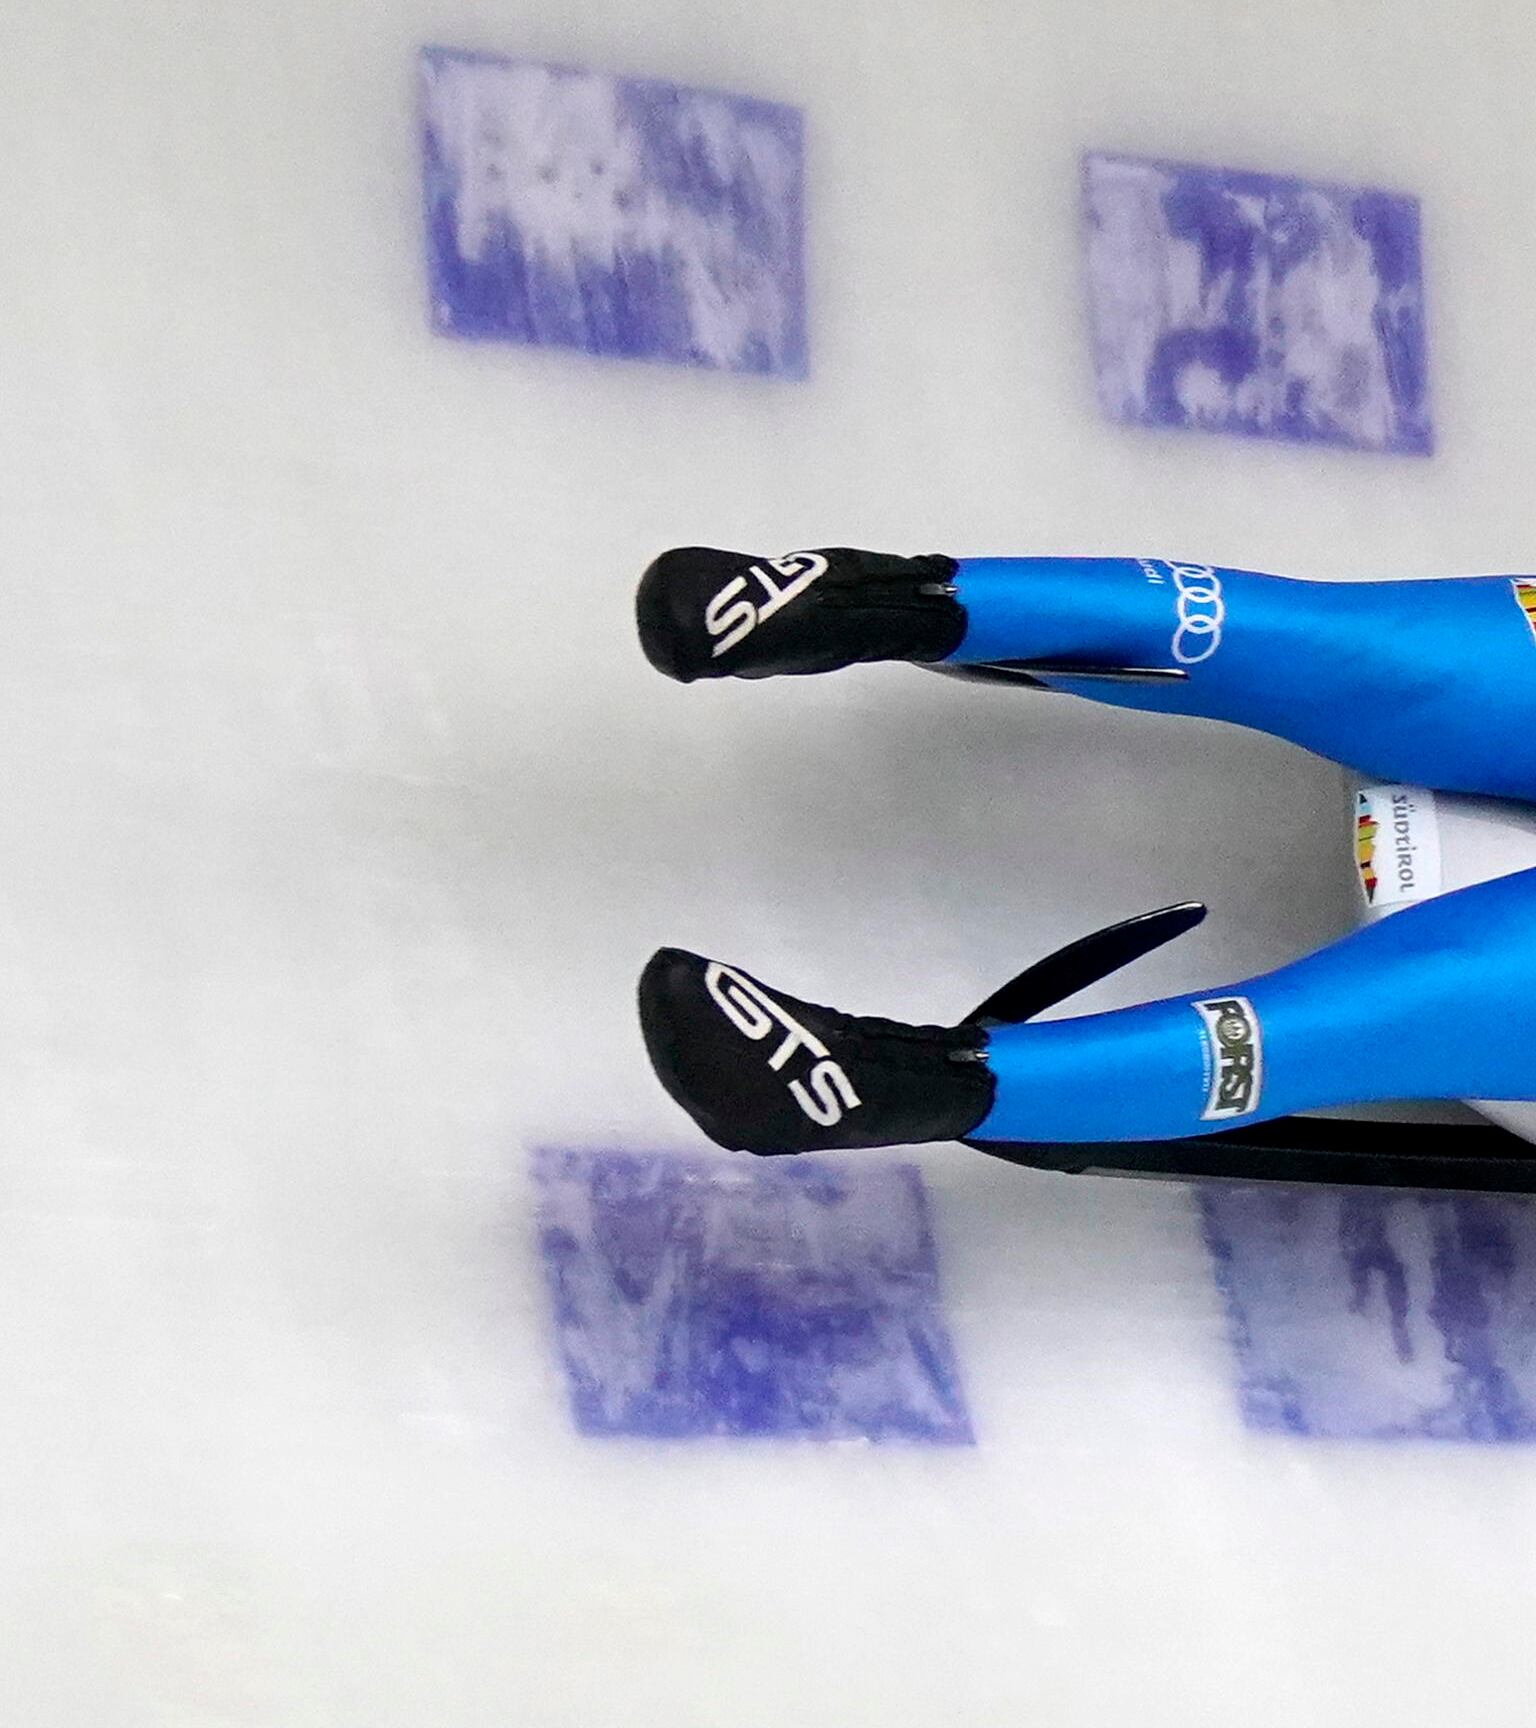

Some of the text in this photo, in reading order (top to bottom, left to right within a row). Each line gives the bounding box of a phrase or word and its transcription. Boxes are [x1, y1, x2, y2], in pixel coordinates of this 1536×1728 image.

[705, 552, 828, 658] GTS
[705, 961, 864, 1127] GTS
[1203, 1000, 1254, 1113] FORST
